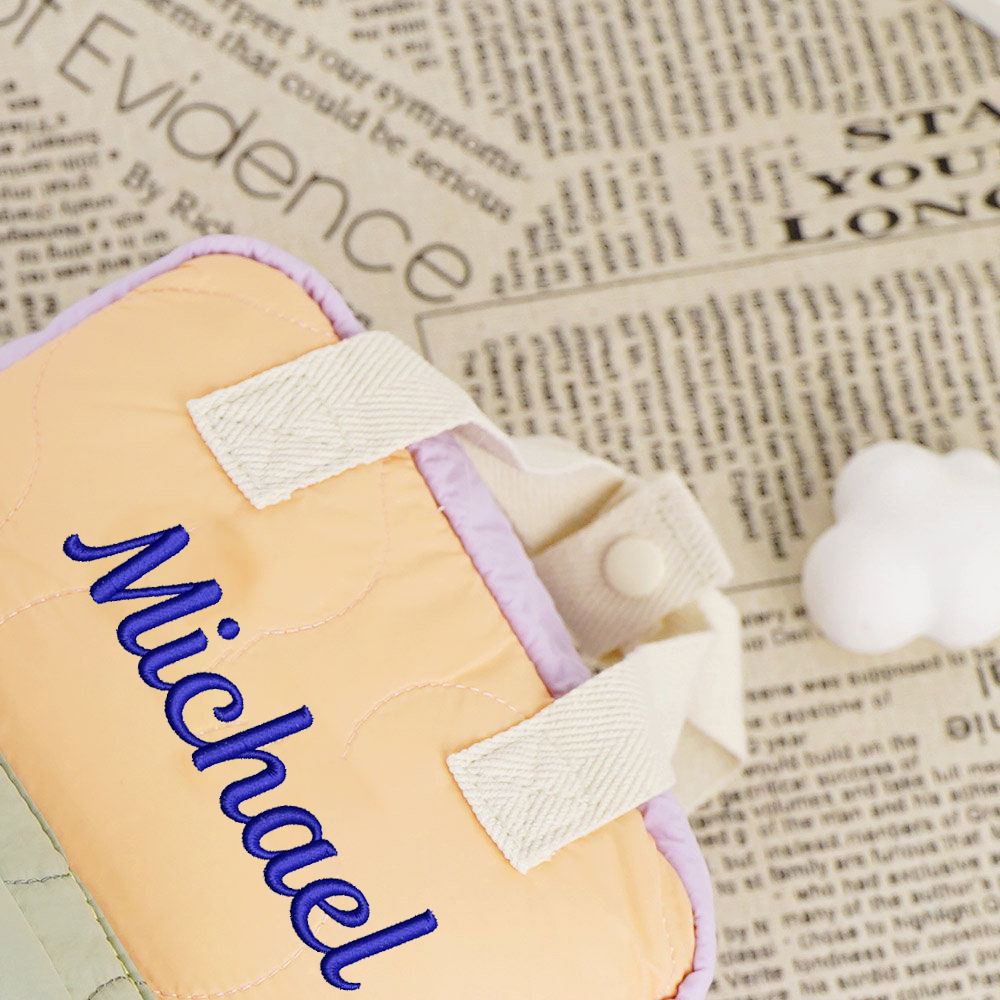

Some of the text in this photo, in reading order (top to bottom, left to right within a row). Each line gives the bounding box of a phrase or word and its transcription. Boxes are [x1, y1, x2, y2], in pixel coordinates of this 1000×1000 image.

[57, 10, 472, 302] Evidence
[217, 31, 280, 79] that
[280, 72, 371, 134] could
[299, 36, 374, 90] your
[63, 524, 437, 990] Michael
